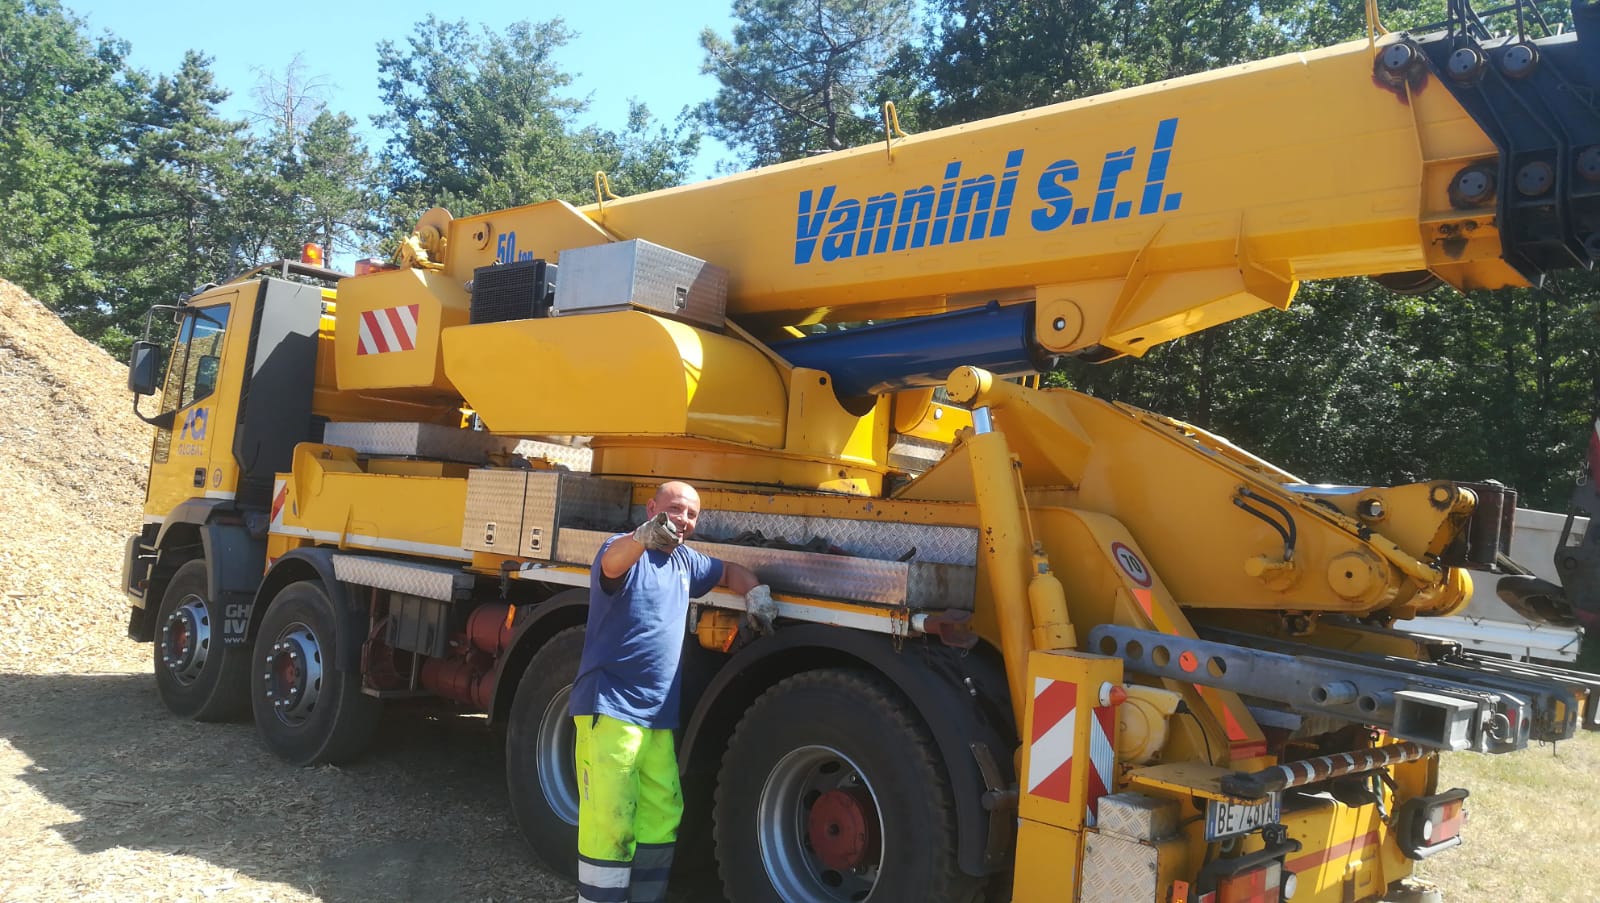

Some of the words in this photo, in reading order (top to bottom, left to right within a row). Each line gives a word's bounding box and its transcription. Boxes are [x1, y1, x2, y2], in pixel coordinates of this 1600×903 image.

[794, 149, 1024, 265] Vannini
[1030, 118, 1183, 232] s.r.l.
[497, 231, 515, 263] 50
[177, 443, 204, 456] GLOBAL
[1120, 553, 1142, 573] 70
[1217, 803, 1234, 833] BE
